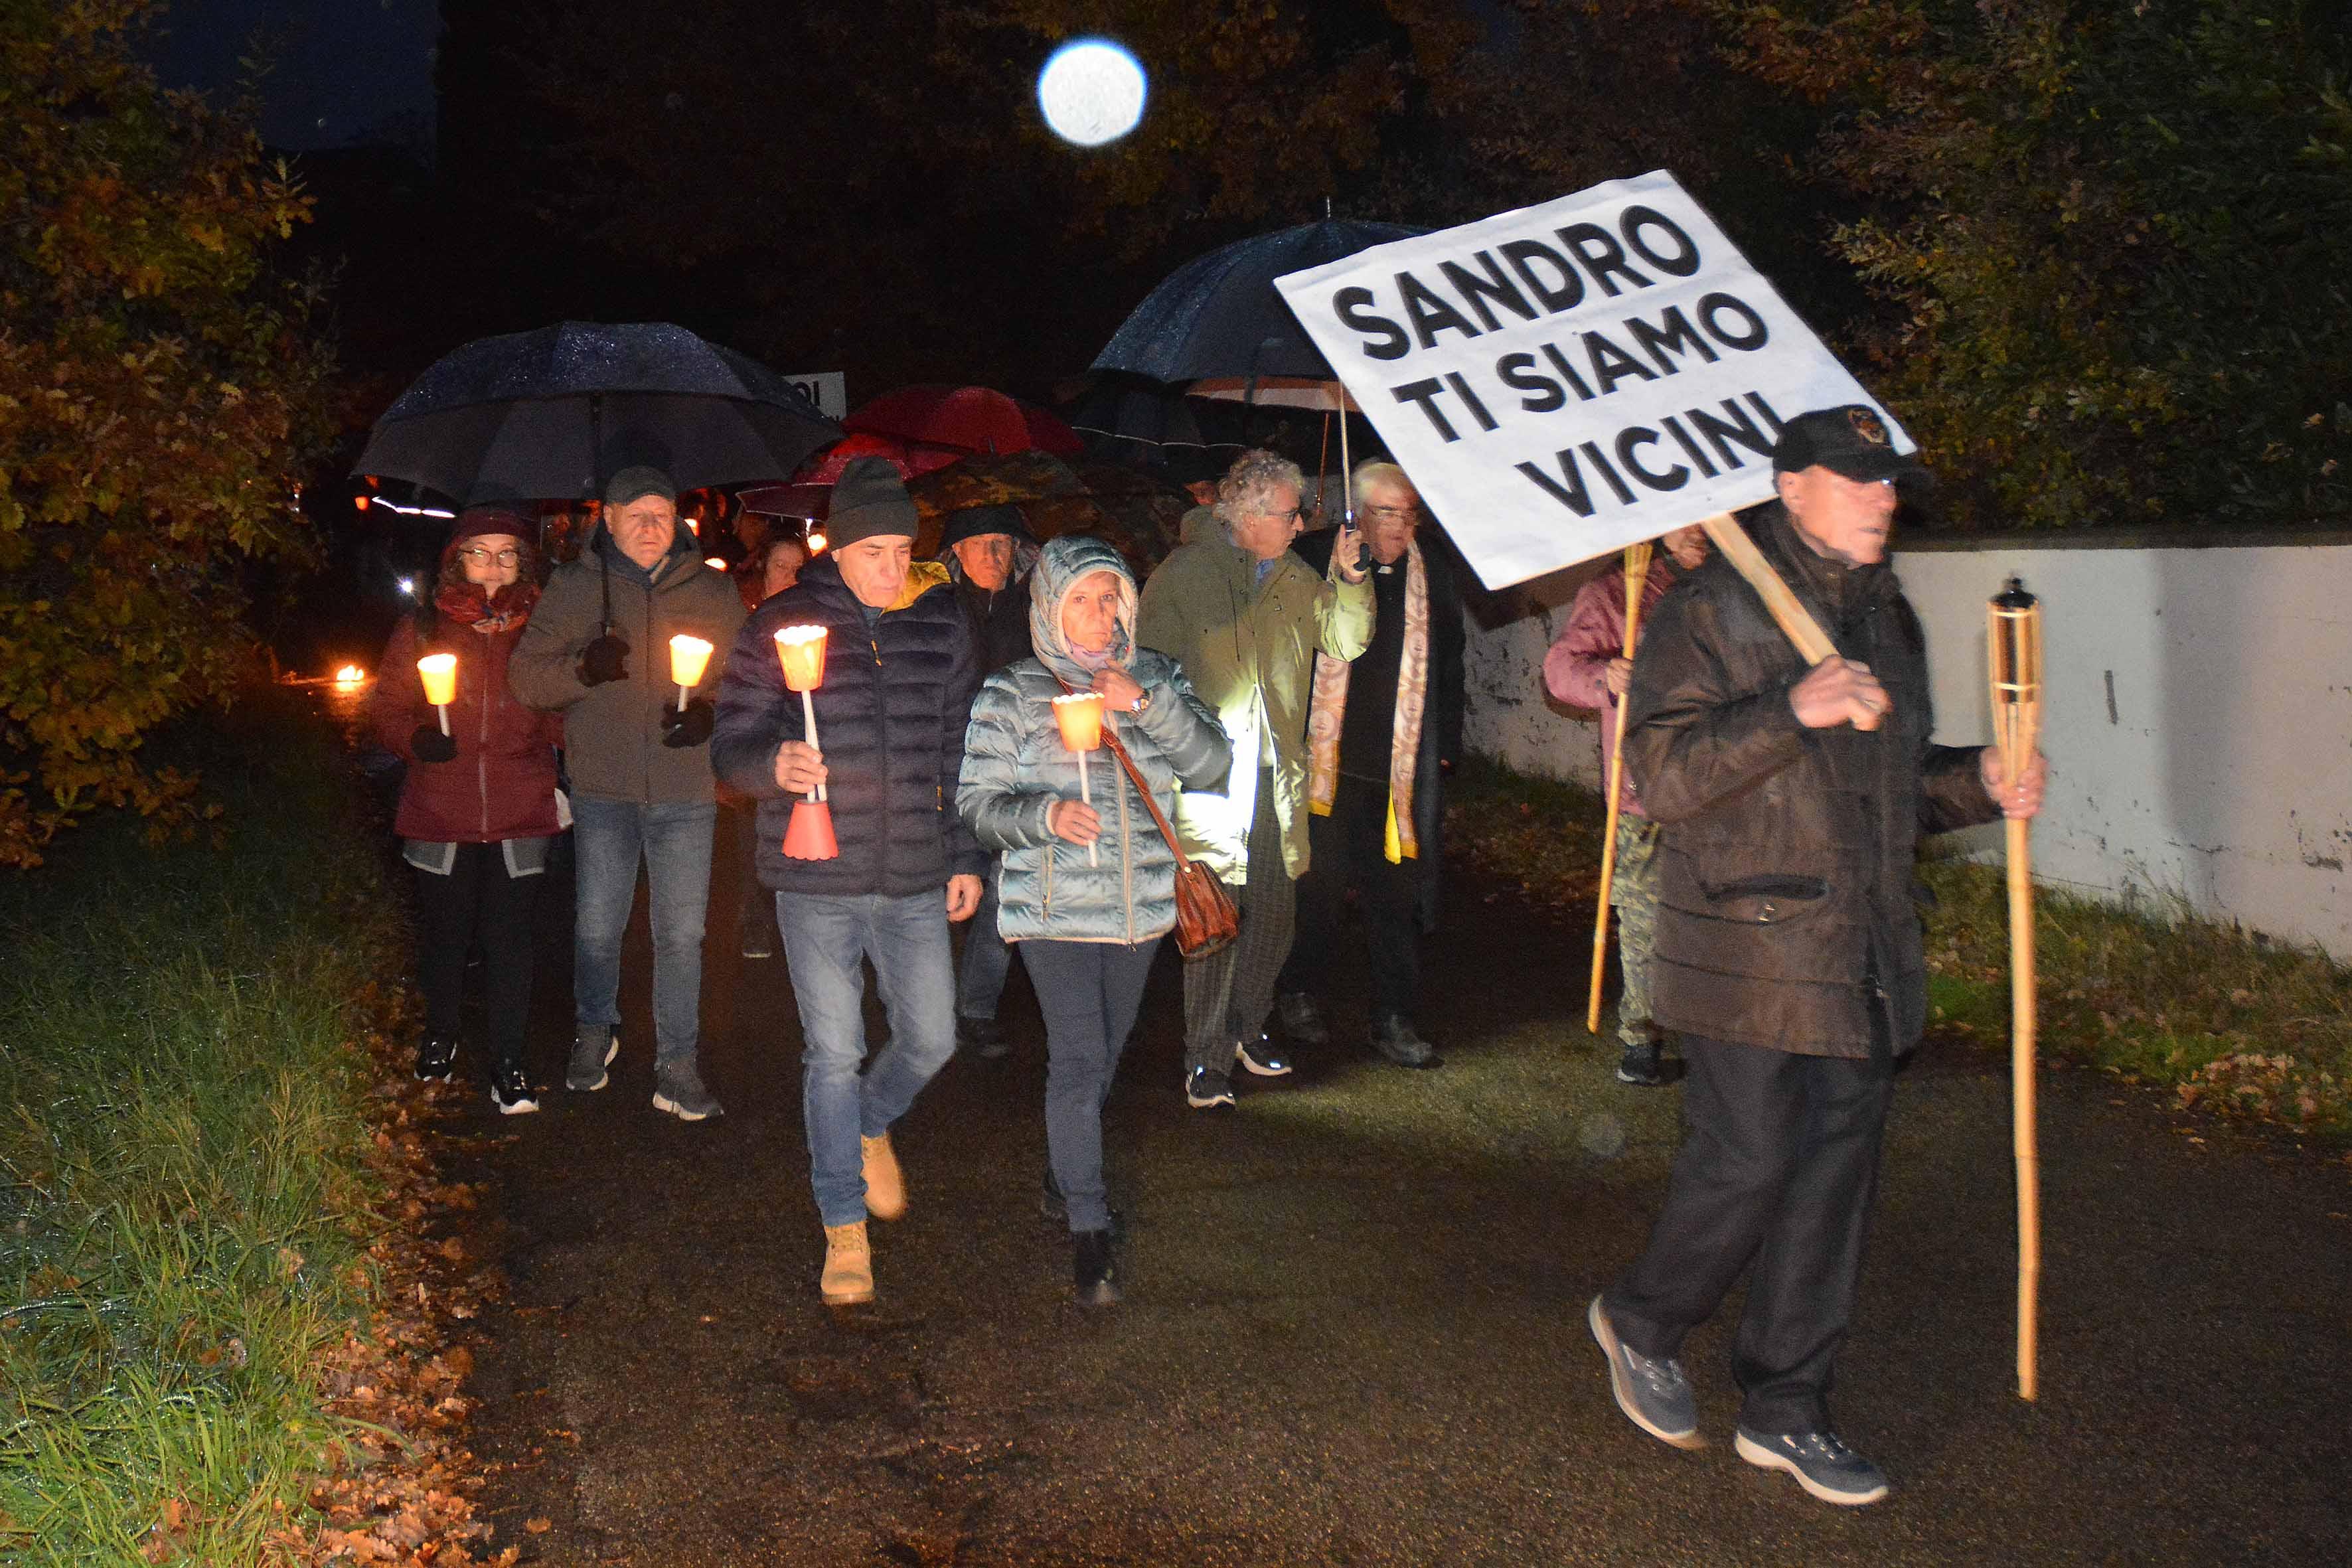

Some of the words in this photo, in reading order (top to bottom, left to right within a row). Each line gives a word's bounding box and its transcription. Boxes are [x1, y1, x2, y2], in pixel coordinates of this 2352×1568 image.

[1333, 204, 1700, 360] SANDRO
[1391, 371, 1500, 442] TI
[1496, 292, 1768, 413] SIAMO
